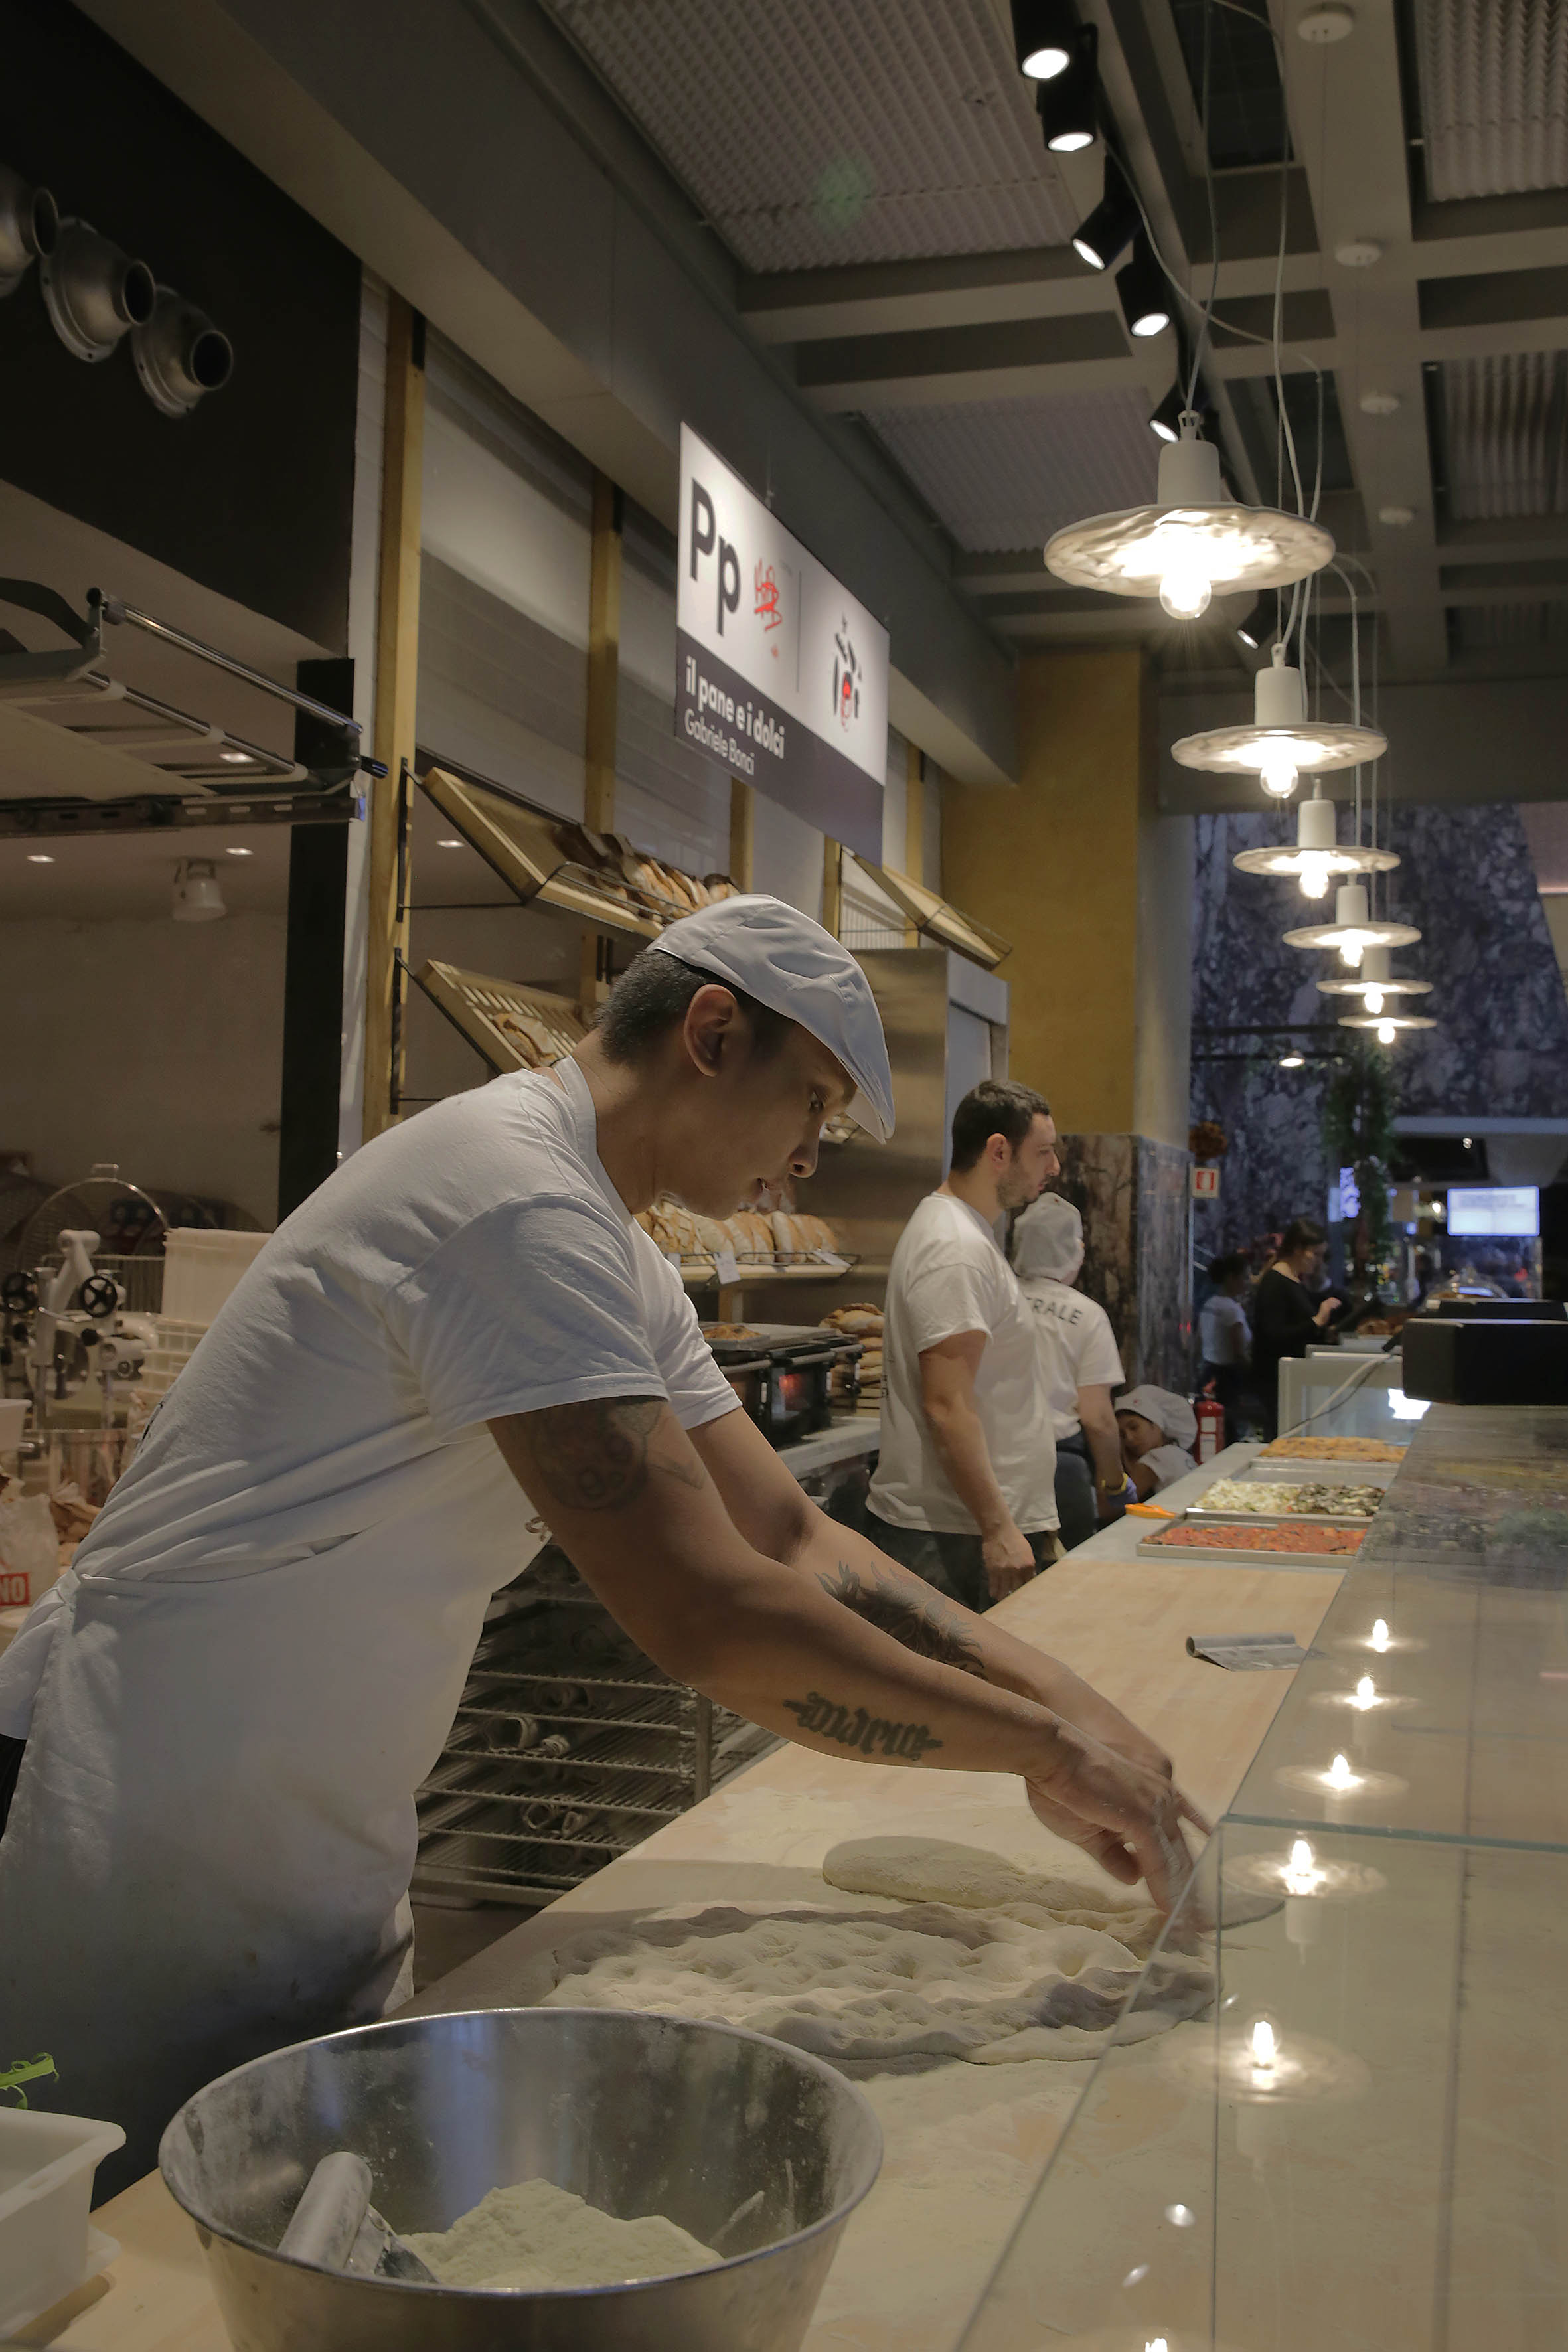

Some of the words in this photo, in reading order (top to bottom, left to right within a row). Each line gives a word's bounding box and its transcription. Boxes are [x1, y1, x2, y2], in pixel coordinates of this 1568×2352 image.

[690, 477, 742, 637] Pp
[684, 708, 729, 758] Gabriele
[728, 737, 755, 775] Bonci
[685, 655, 697, 696] il
[698, 675, 735, 723] pane
[735, 705, 746, 731] e
[745, 701, 753, 737] i
[753, 709, 785, 759] dolci
